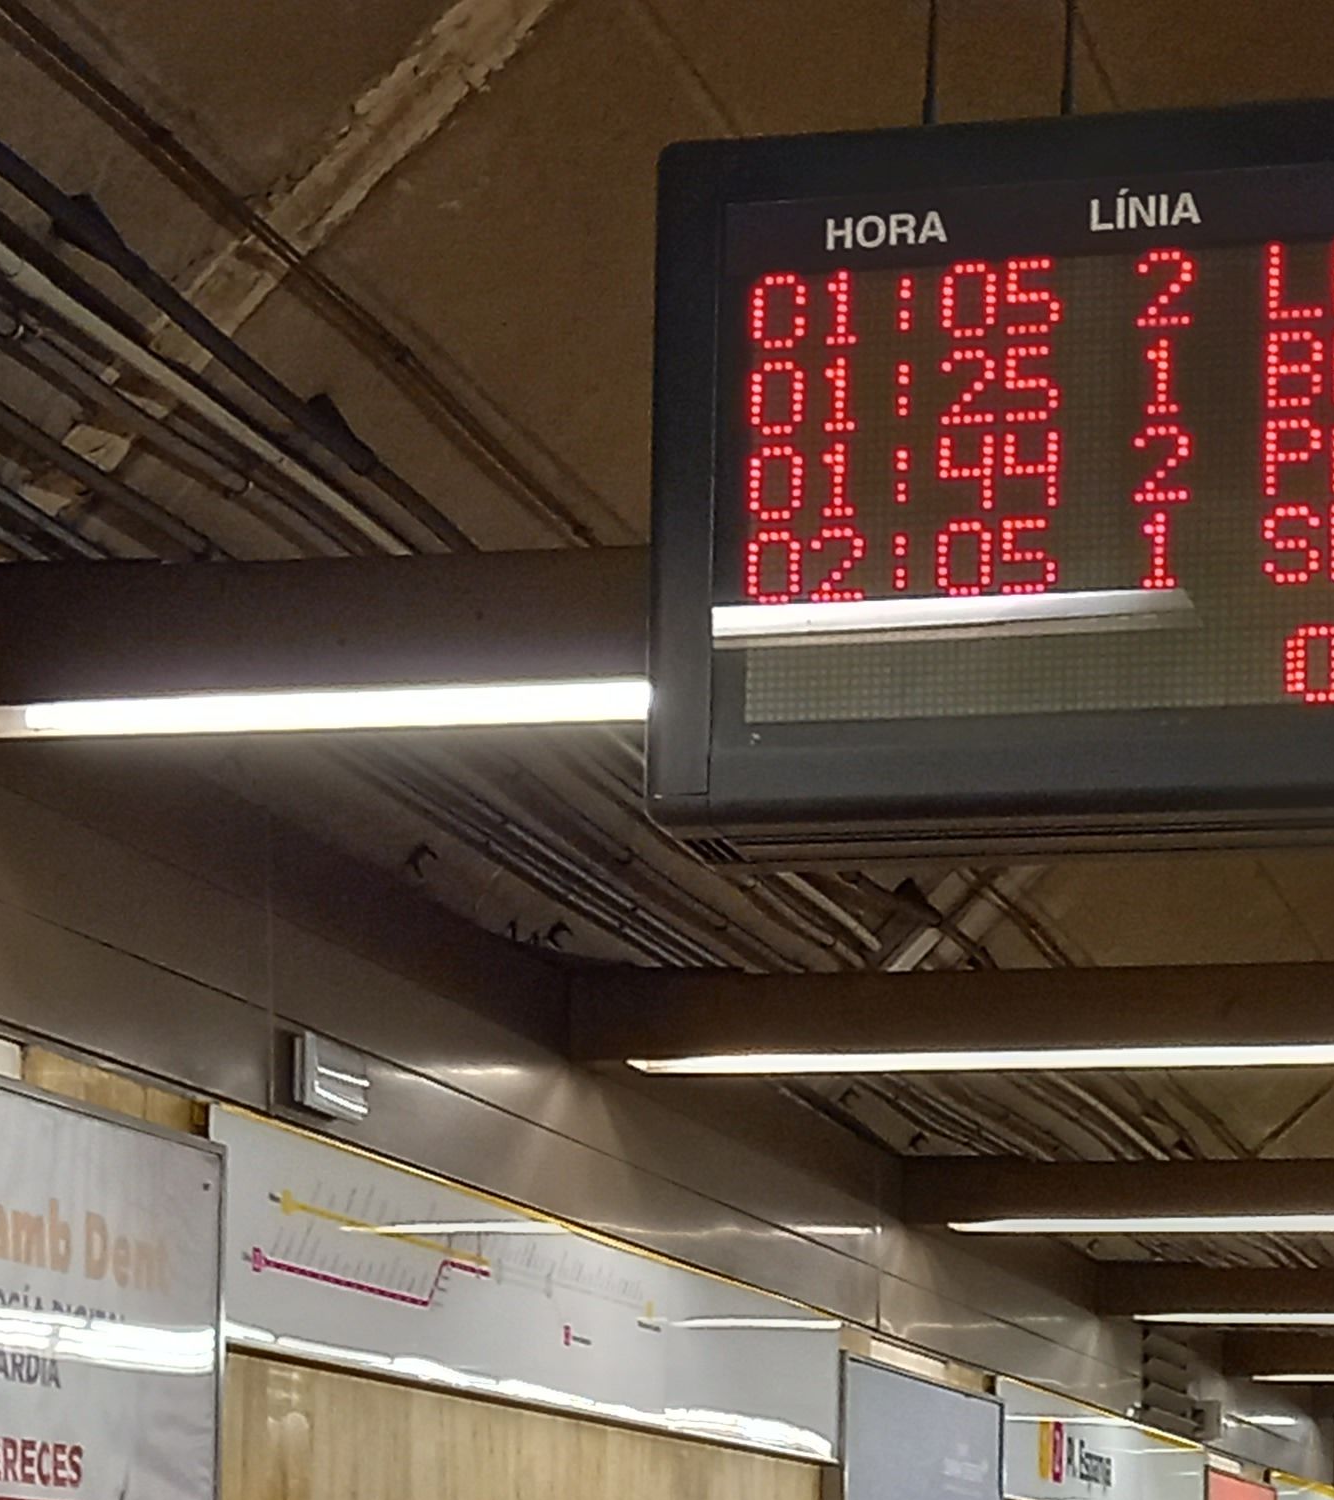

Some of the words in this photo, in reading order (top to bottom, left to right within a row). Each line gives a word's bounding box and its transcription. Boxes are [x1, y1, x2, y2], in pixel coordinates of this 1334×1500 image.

[826, 212, 948, 250] HORA
[1090, 187, 1202, 232] LÍNIA
[750, 256, 1062, 350] 01:05
[1136, 248, 1194, 328] 2
[749, 345, 1061, 435] 01:25
[1145, 336, 1180, 416] 1
[747, 430, 1060, 522] 01:44
[1132, 423, 1191, 504] 2
[746, 516, 1058, 605] 02:05
[1141, 510, 1177, 589] 1
[84, 1210, 173, 1298] Dent
